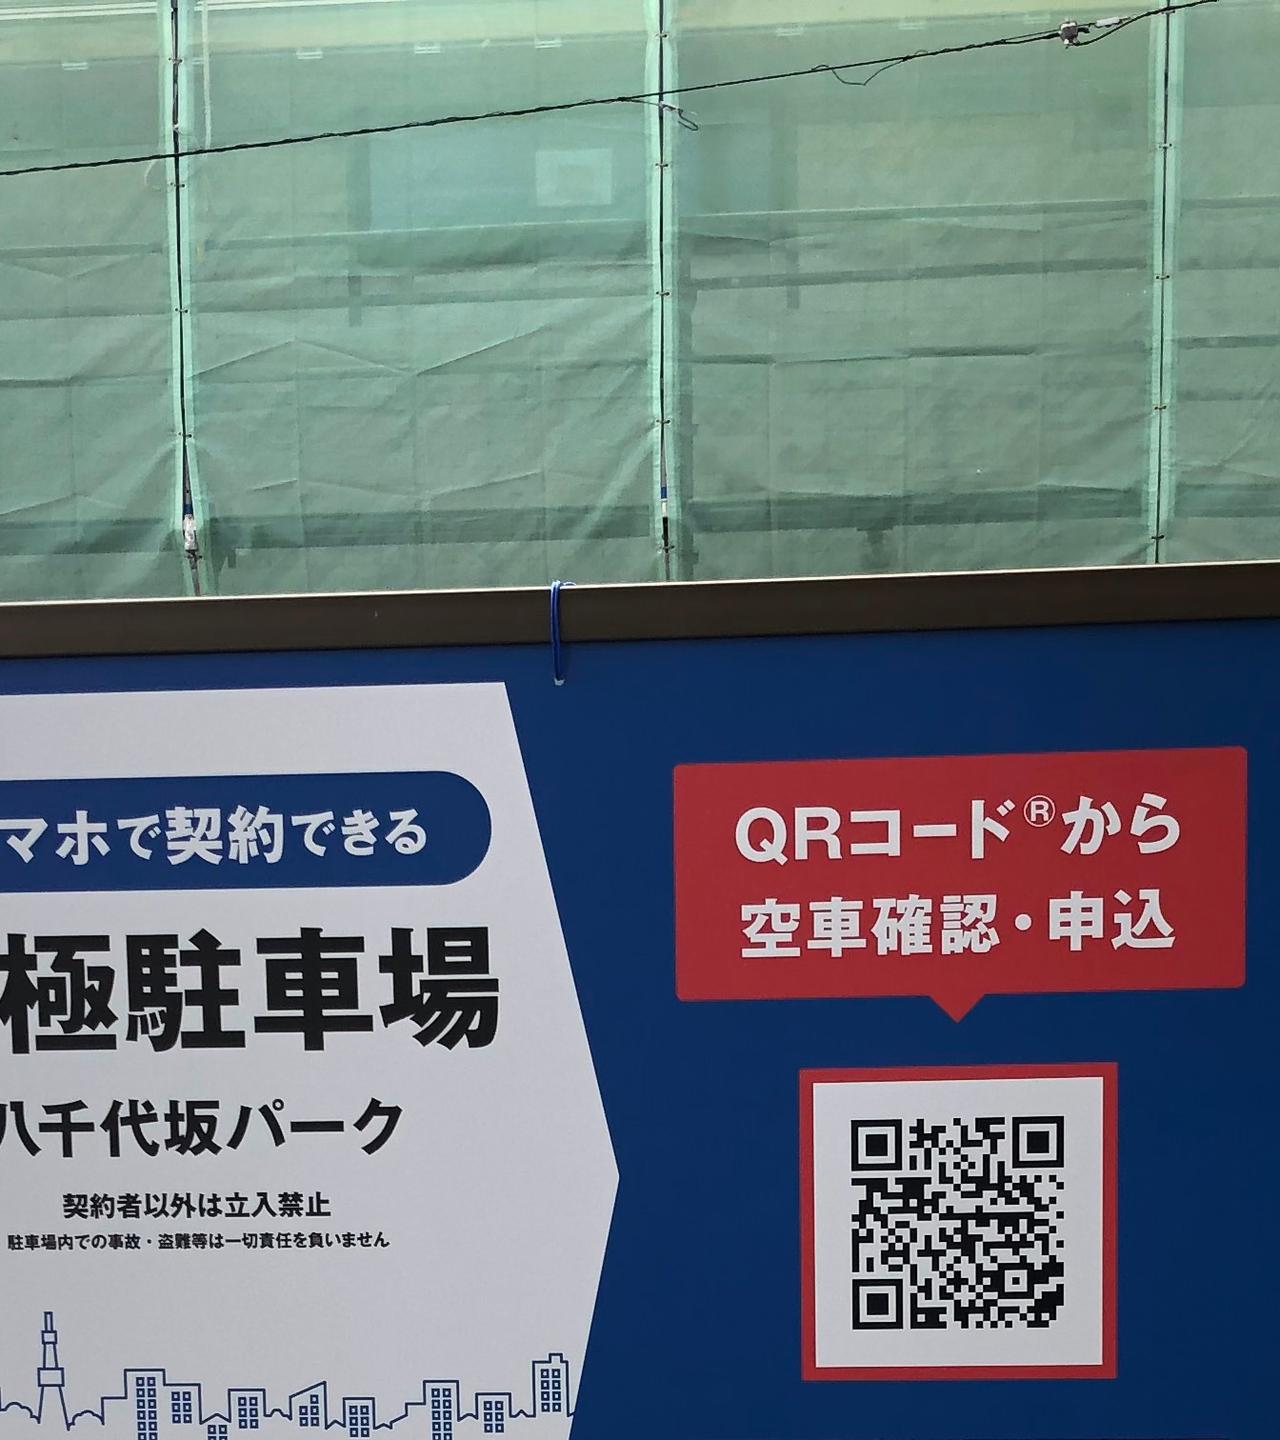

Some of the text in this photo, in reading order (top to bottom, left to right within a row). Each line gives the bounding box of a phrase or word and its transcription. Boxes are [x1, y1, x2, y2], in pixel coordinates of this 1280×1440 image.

[741, 888, 1176, 958] 空車確認・申込
[62, 1191, 332, 1220] 契約者以外は立入禁止
[7, 1231, 391, 1251] 駐車場内での事故・盗難等は一切責任を負いません
